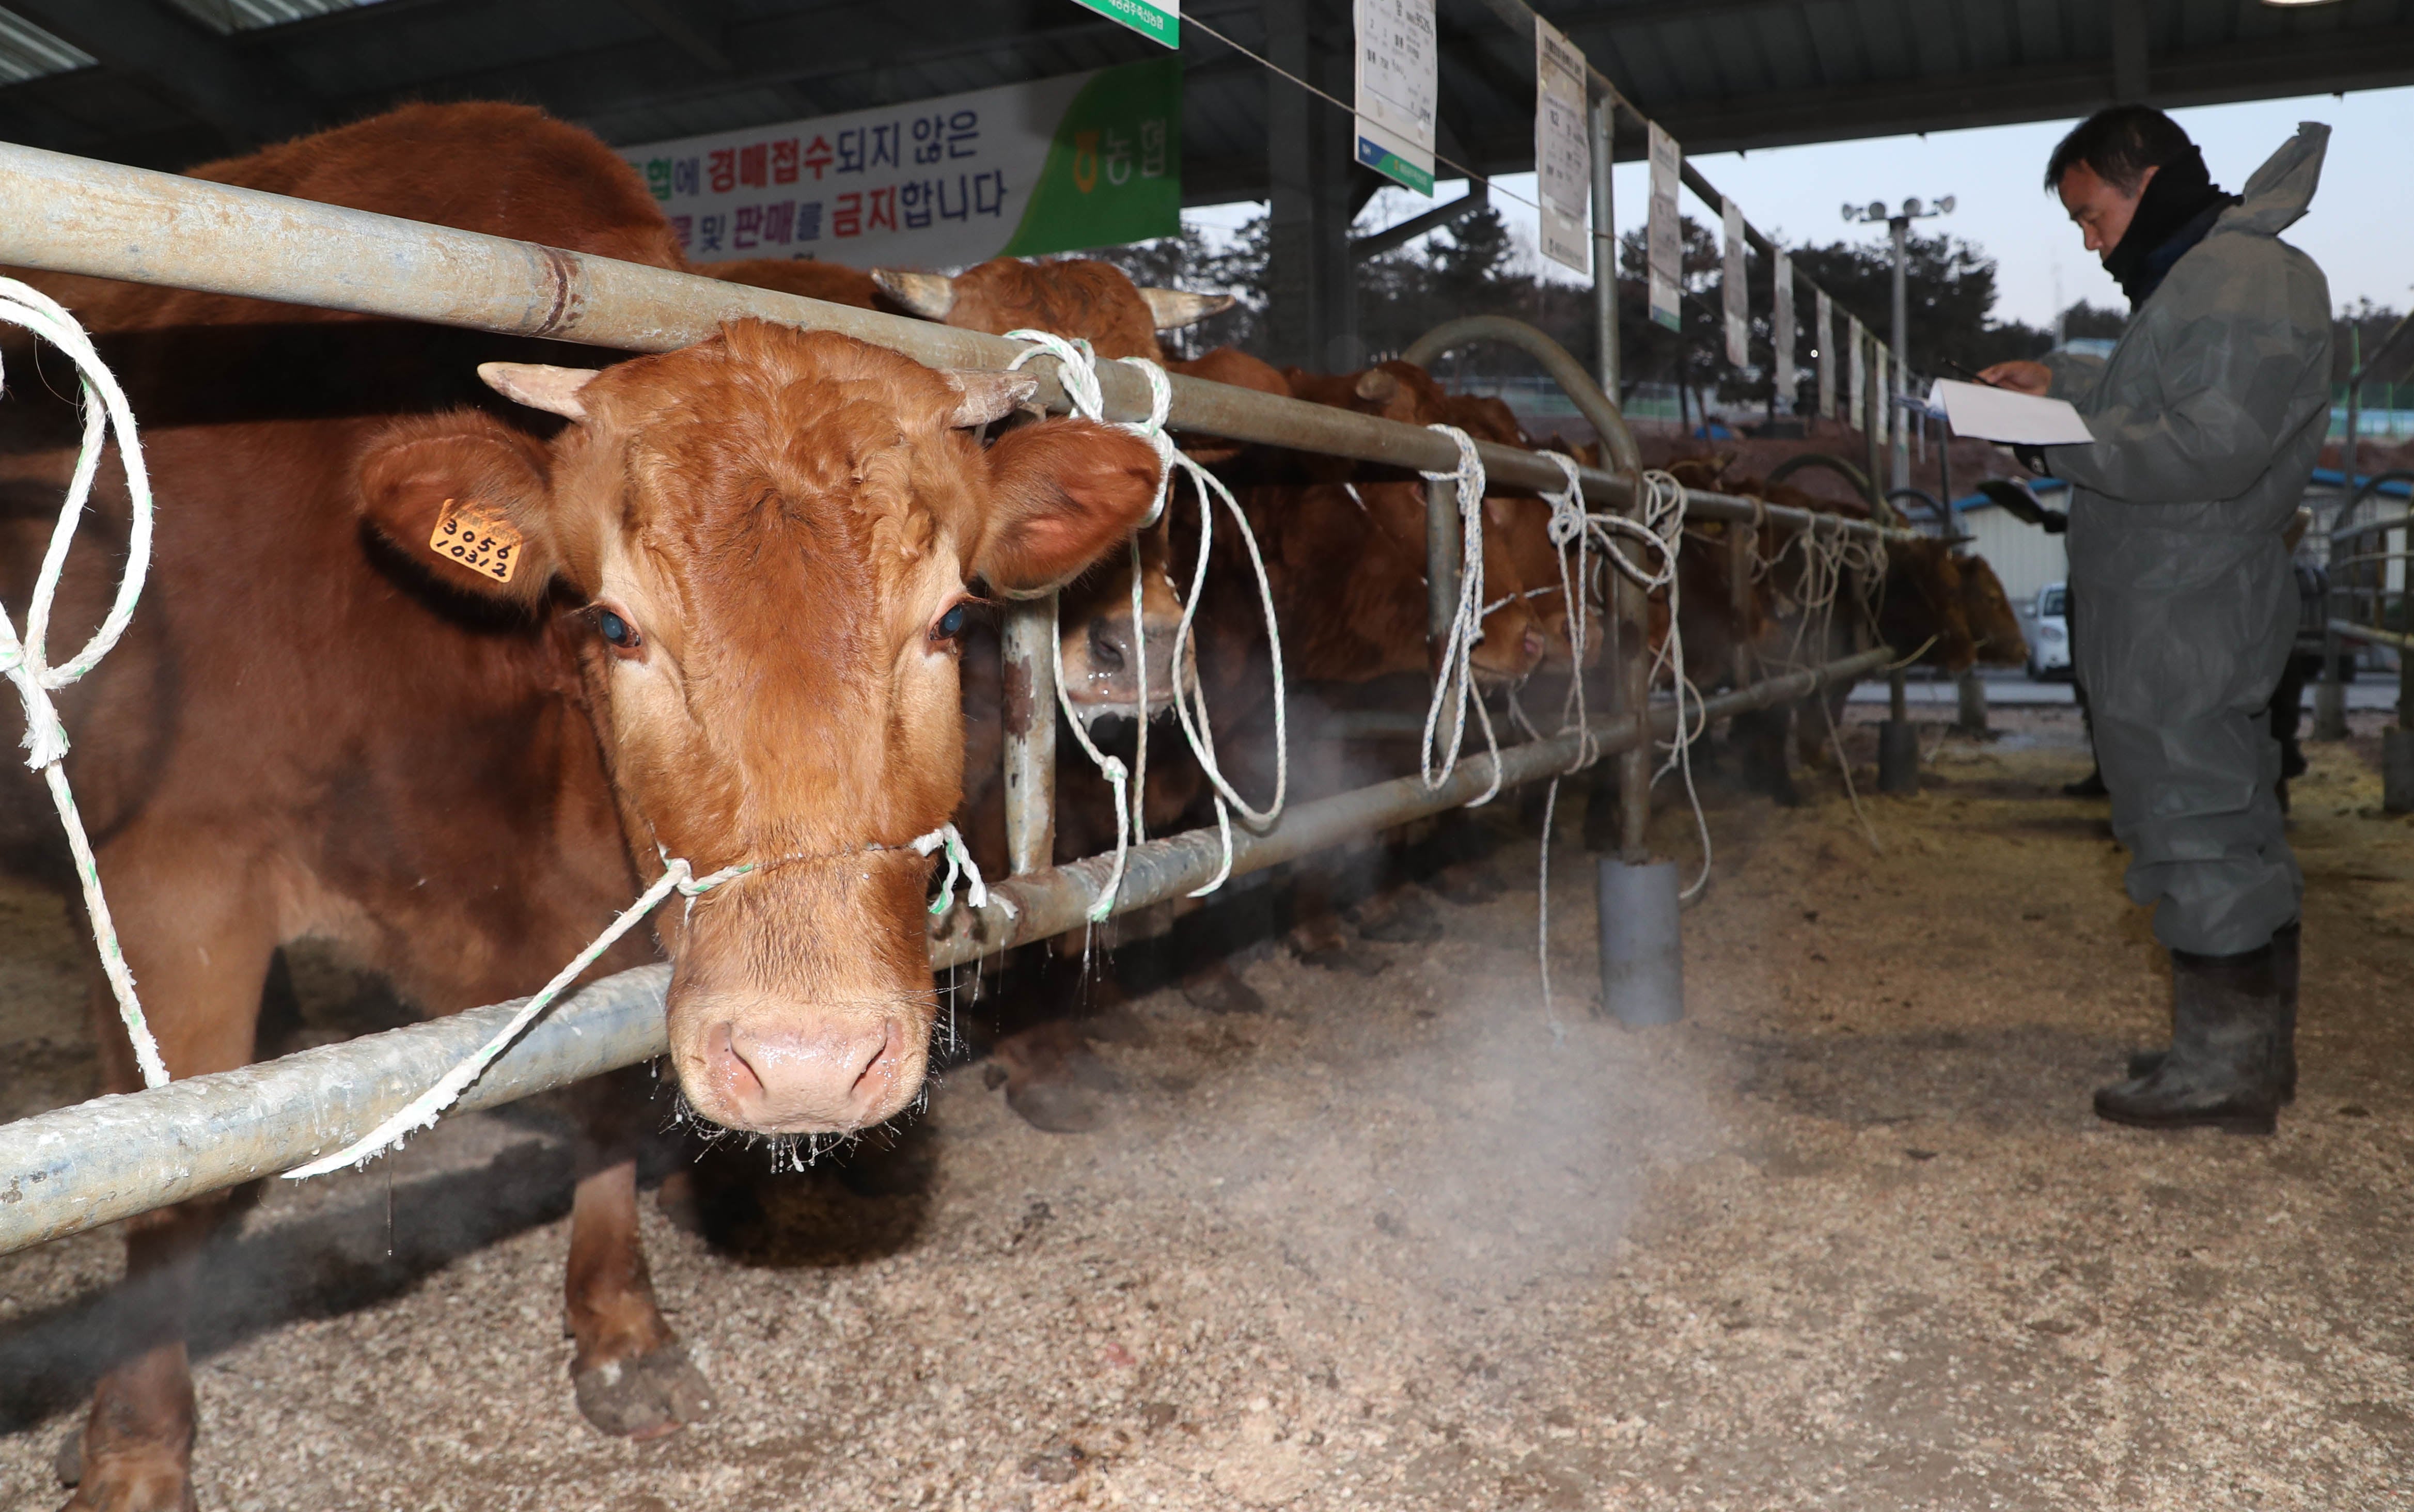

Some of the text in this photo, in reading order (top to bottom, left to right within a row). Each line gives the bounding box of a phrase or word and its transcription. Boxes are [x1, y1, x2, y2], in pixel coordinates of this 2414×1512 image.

[628, 109, 980, 200] 협에 경매접수되지 않은
[700, 214, 726, 253] 및
[732, 199, 823, 250] 판매를
[832, 168, 1008, 239] 금지합니다
[443, 518, 512, 559] 3056
